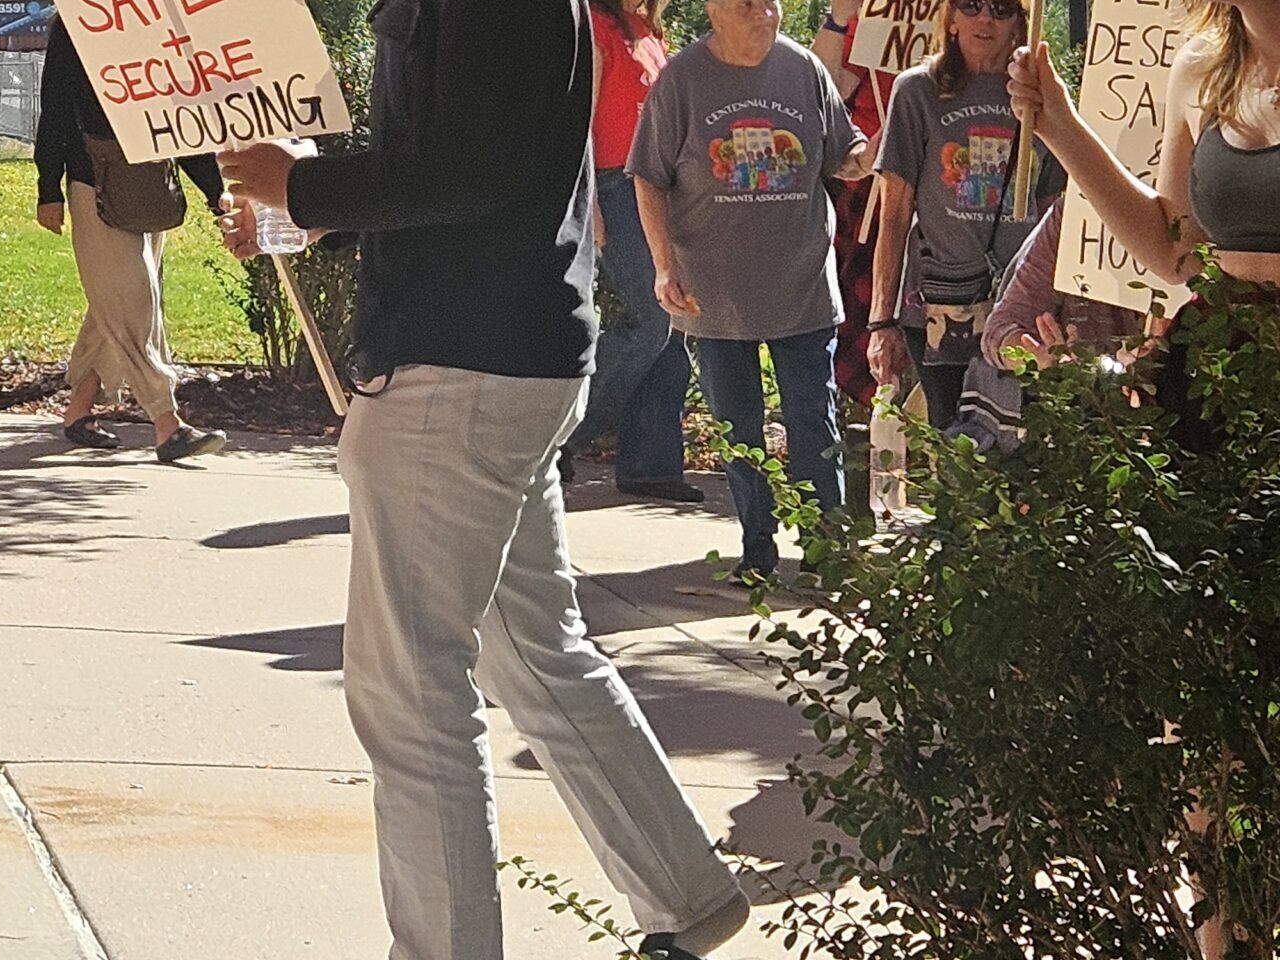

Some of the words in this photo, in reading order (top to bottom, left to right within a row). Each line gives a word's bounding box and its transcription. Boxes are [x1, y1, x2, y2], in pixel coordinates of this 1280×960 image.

[162, 29, 191, 56] +
[880, 23, 933, 70] NO
[1088, 23, 1181, 69] DESE
[100, 38, 263, 104] SECURE
[145, 74, 326, 153] HOUSING
[705, 99, 770, 125] CENTENNIAL
[771, 101, 803, 123] PLAZA
[714, 194, 754, 203] TENANTS
[755, 192, 808, 202] ASSOCIATION
